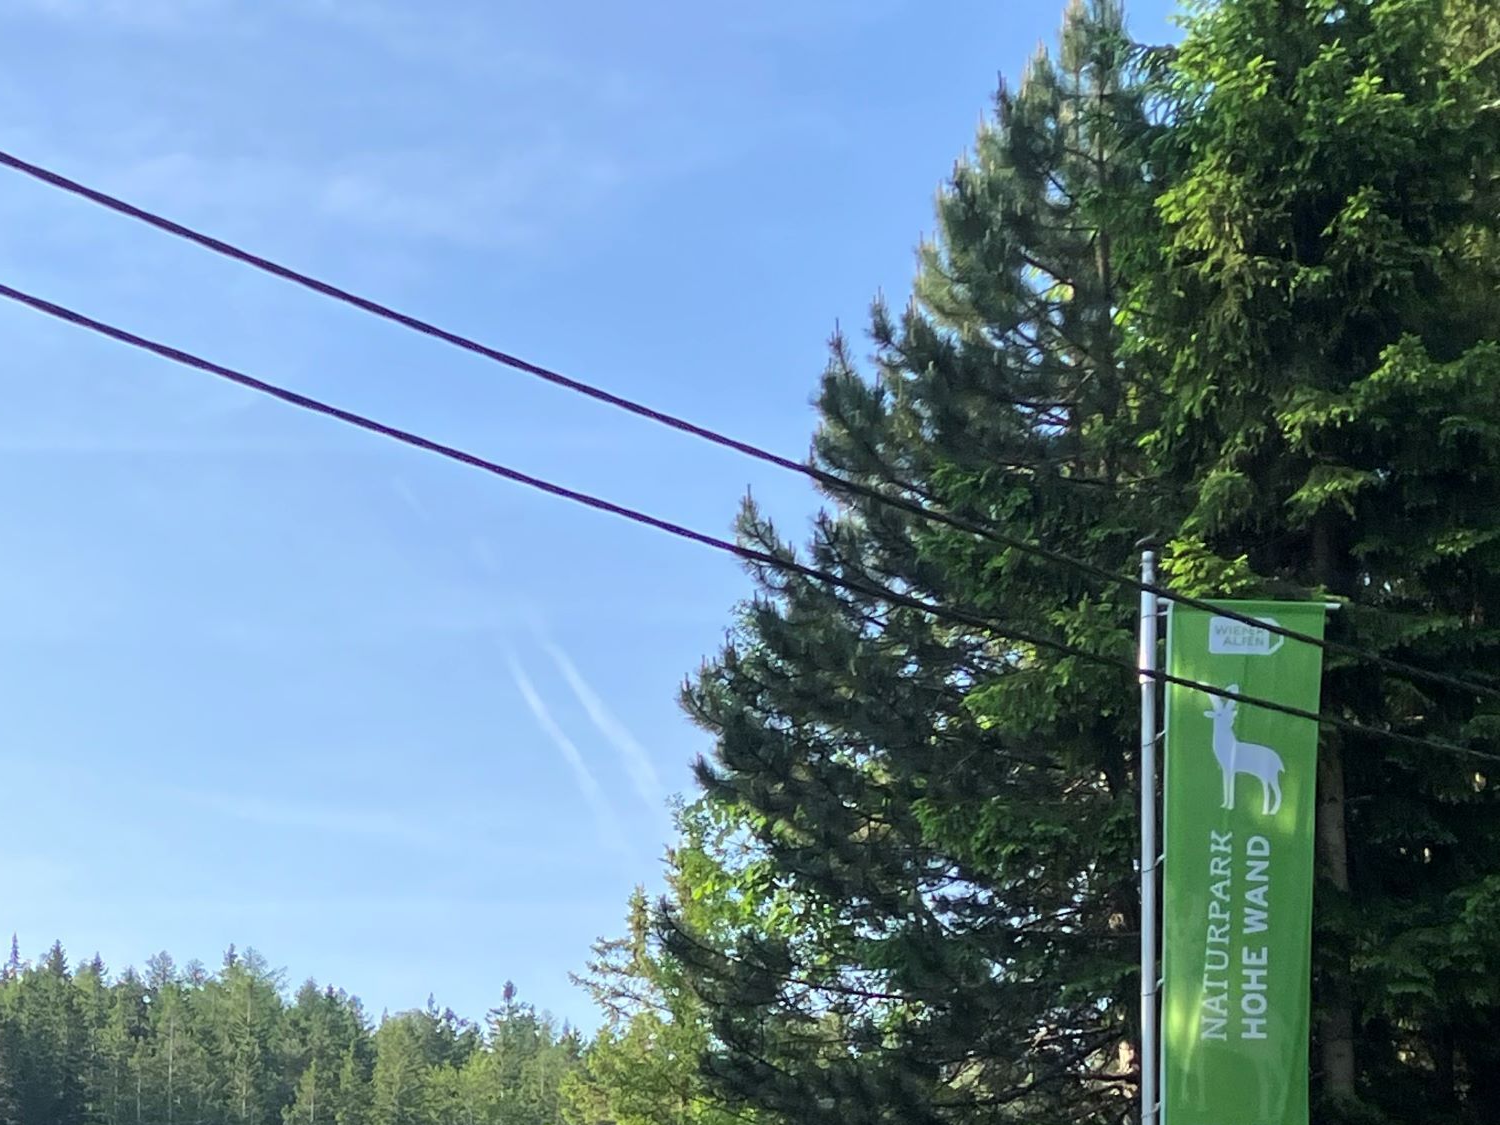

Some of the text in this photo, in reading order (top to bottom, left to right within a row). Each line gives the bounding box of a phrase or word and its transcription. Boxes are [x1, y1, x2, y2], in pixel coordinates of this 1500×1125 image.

[1201, 829, 1233, 1041] NATURPARK
[1241, 835, 1270, 1039] HOHE WAND
